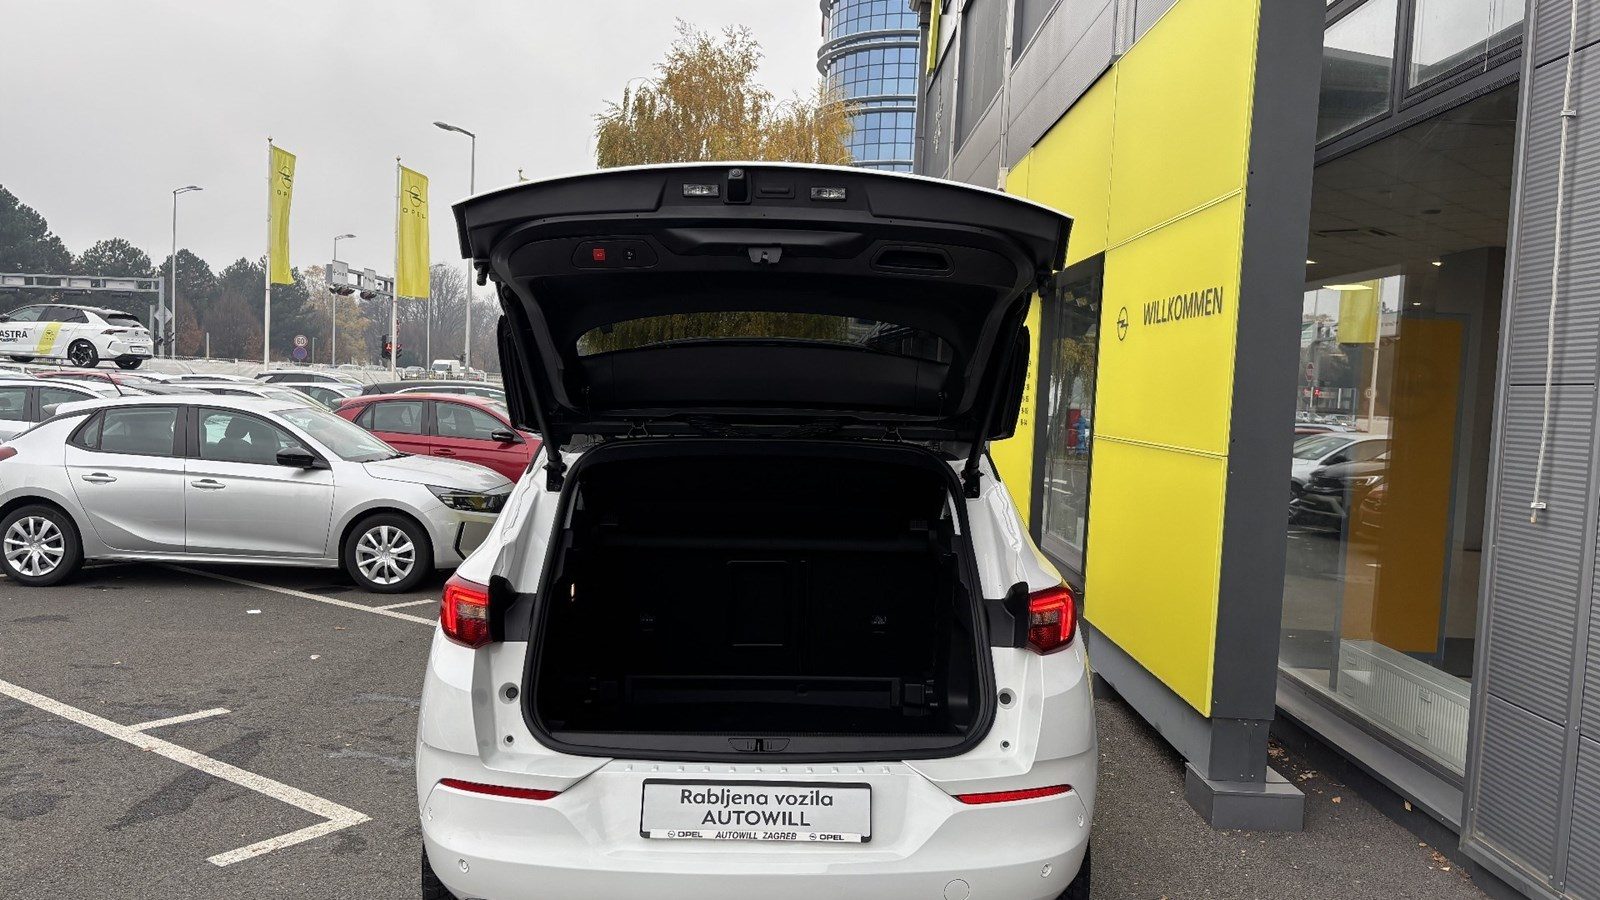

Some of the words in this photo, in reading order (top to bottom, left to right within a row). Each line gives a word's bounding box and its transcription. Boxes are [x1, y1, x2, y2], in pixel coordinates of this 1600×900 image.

[402, 207, 426, 219] OPEL
[1143, 286, 1223, 325] WILLKOMMEN
[0, 330, 28, 338] ASTRA
[680, 788, 768, 809] Rabljena
[775, 790, 833, 806] vozila
[701, 810, 811, 826] AUTOWILL
[677, 830, 703, 838] OPEL
[715, 831, 758, 840] AUTOWILL
[762, 832, 797, 840] ZAGREB
[819, 833, 844, 841] OPEL
